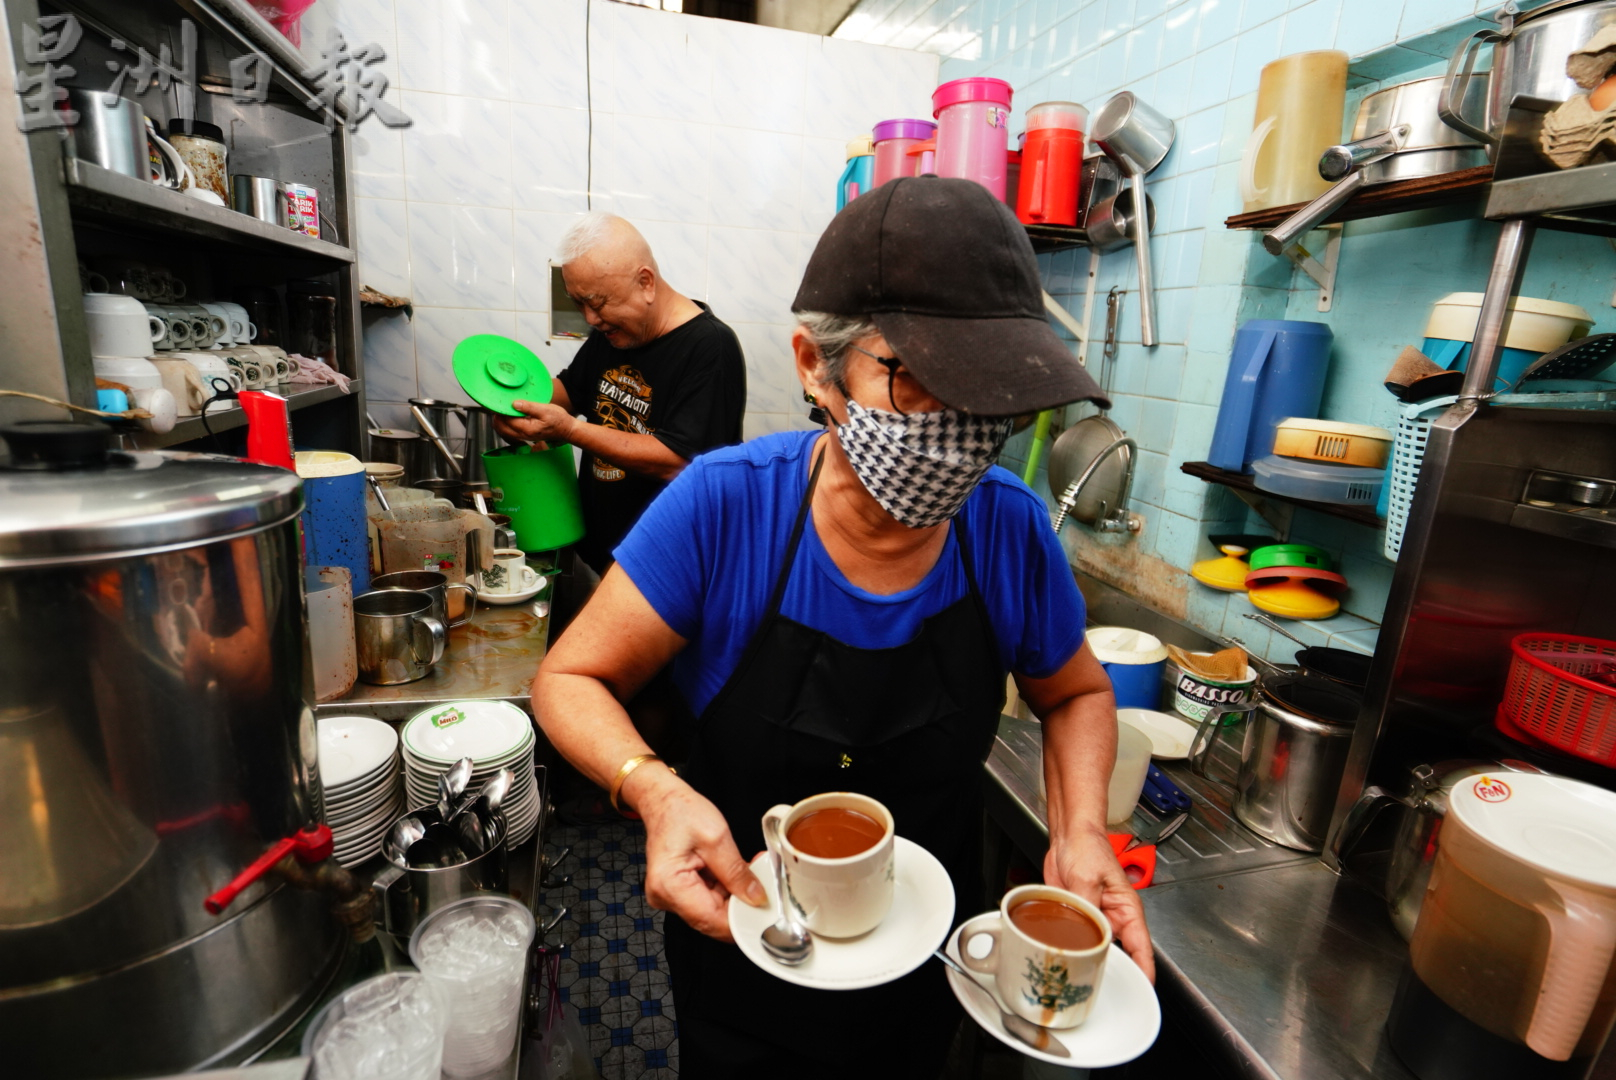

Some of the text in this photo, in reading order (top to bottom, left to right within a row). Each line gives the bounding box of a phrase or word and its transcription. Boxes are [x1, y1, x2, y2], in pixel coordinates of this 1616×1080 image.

[288, 204, 315, 214] TRIK
[1180, 678, 1244, 703] BASSO
[439, 715, 458, 725] MILO
[1479, 785, 1506, 798] F&N
